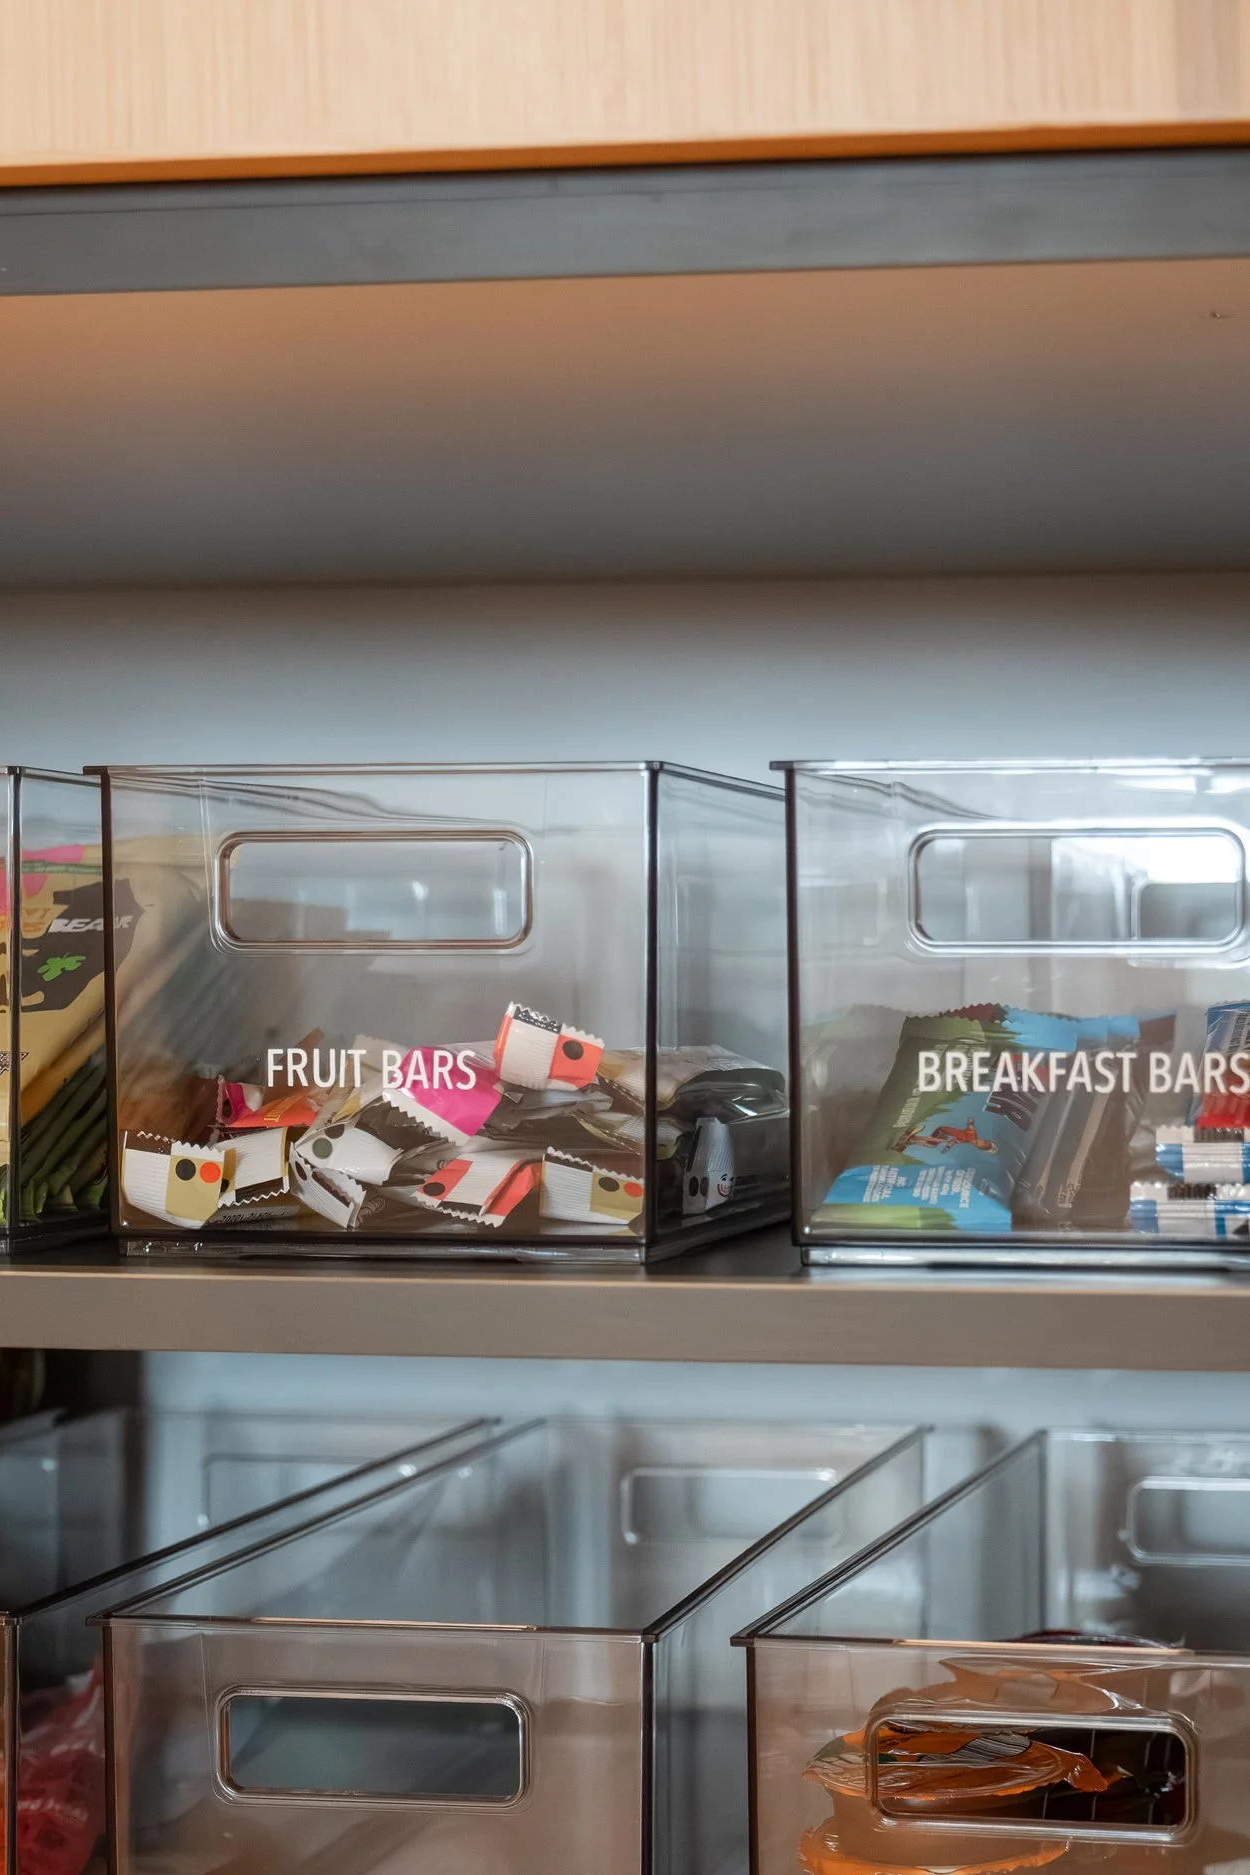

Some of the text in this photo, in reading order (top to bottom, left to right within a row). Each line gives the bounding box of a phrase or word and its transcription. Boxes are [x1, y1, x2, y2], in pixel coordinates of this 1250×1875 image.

[266, 1048, 476, 1091] FRUIT BARS
[917, 1051, 1250, 1096] BREAKFAST BARS
